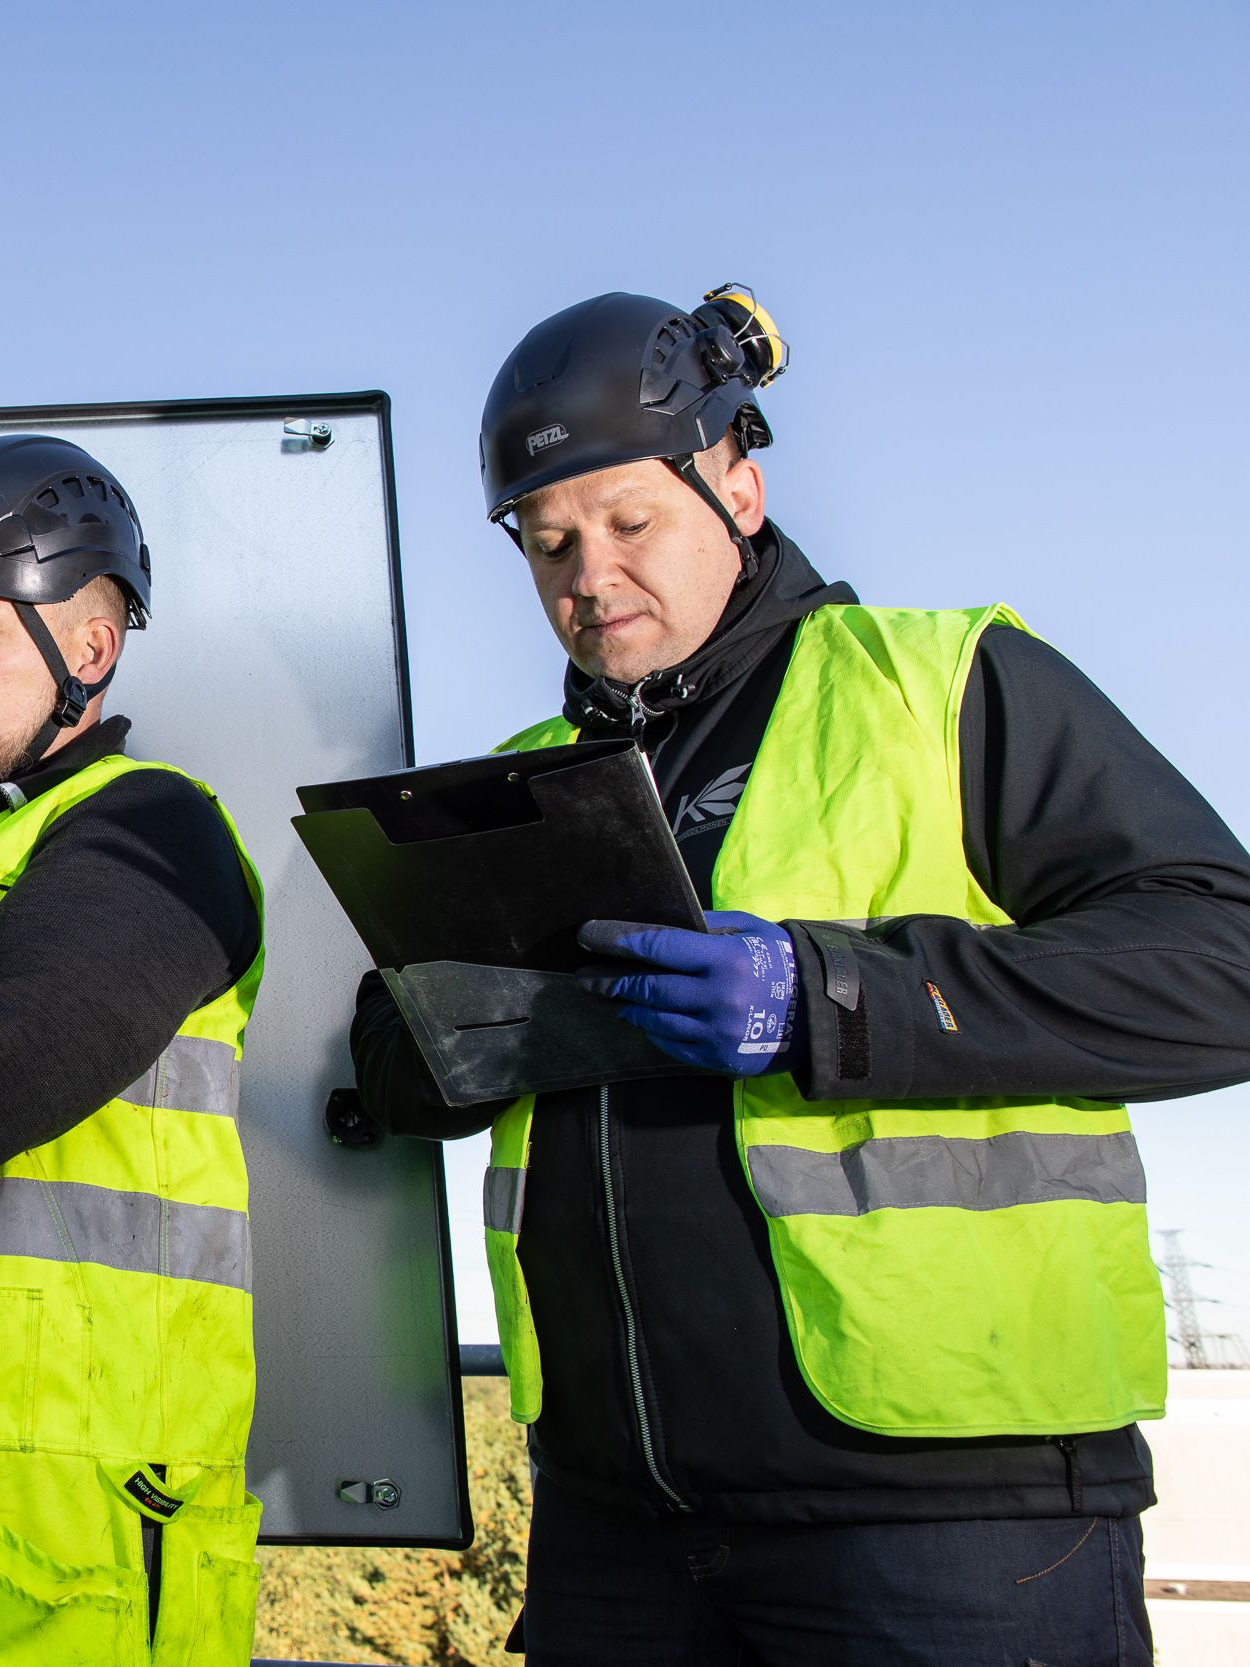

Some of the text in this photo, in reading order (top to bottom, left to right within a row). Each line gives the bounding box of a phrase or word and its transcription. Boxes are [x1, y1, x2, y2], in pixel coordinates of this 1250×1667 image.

[526, 425, 569, 457] PETZL
[750, 1009, 766, 1040] 10
[134, 1477, 151, 1495] HIGH
